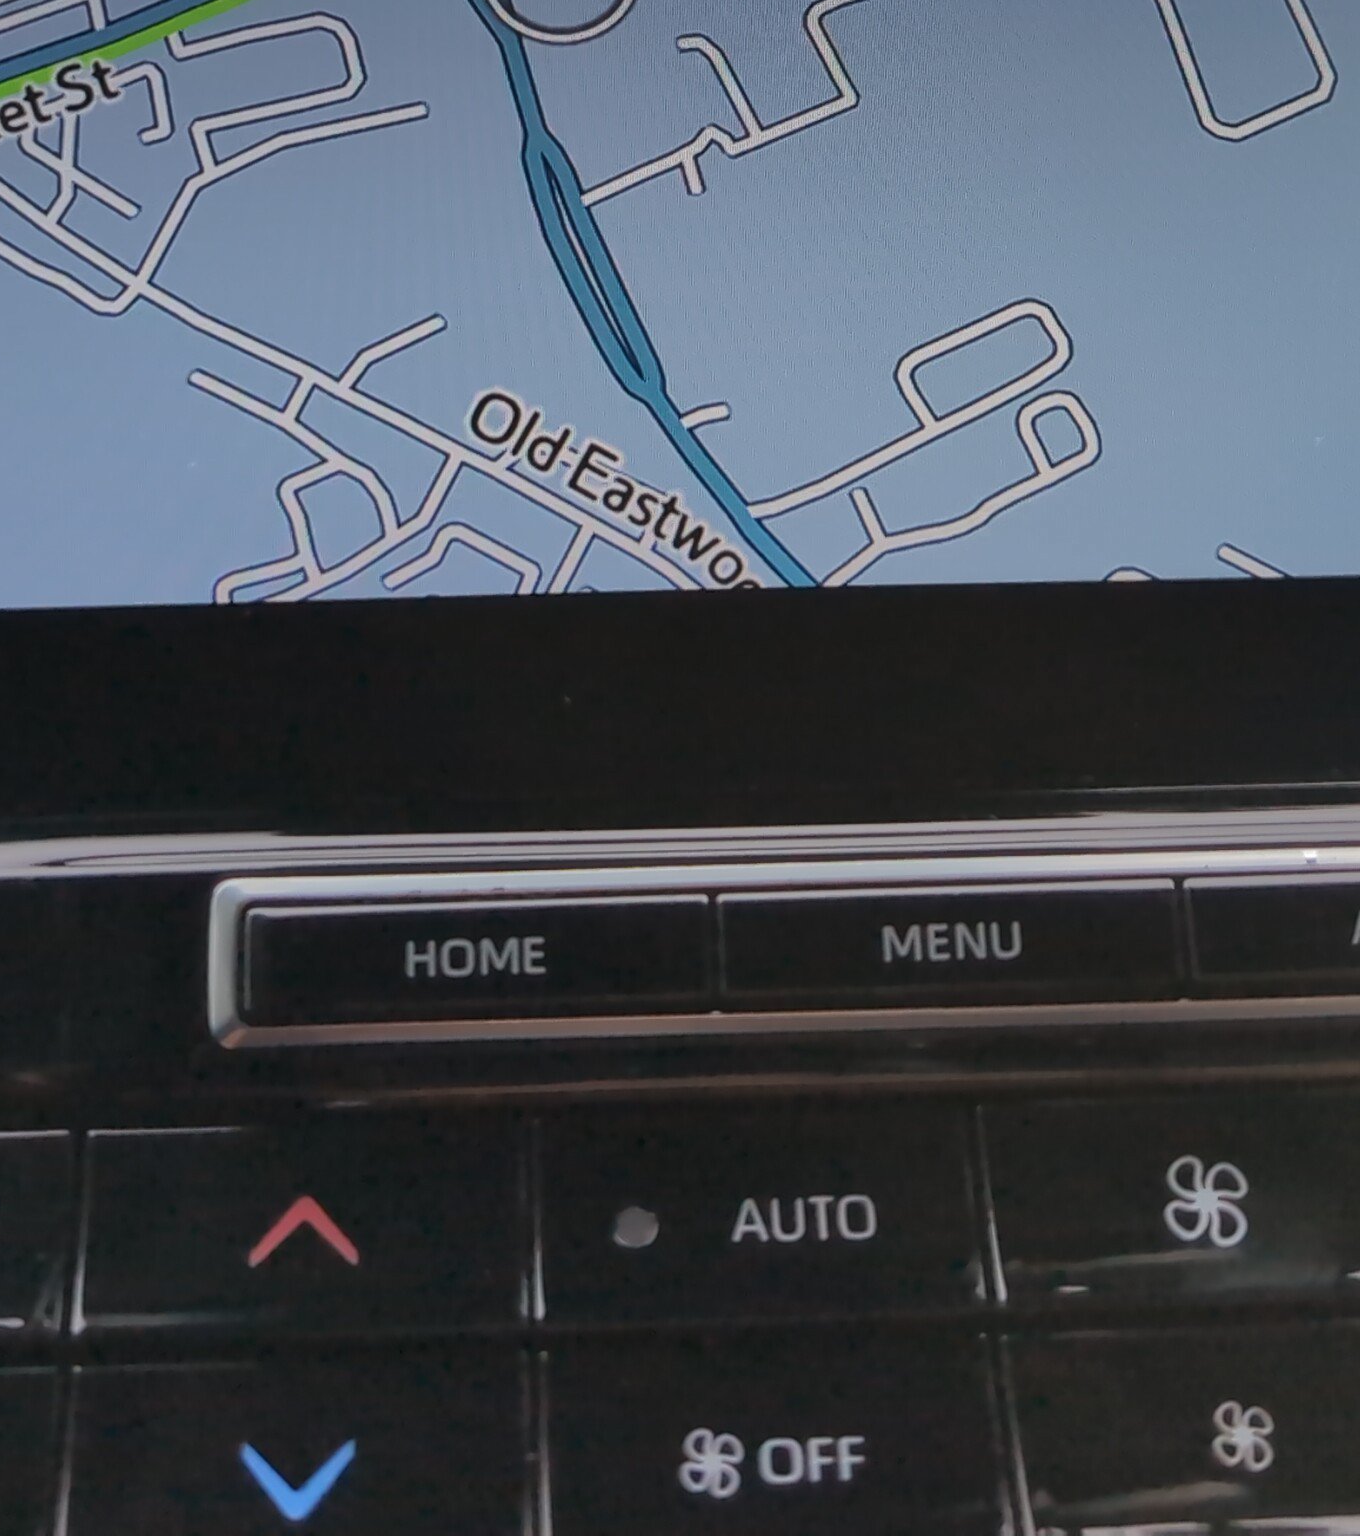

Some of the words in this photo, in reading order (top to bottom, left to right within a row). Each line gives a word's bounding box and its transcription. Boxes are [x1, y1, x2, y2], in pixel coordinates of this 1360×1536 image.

[55, 59, 122, 113] St
[469, 392, 572, 473] Old
[404, 935, 547, 979] HOME
[880, 920, 1024, 964] MENU
[731, 1194, 879, 1243] AUTO
[757, 1434, 867, 1485] OFF
